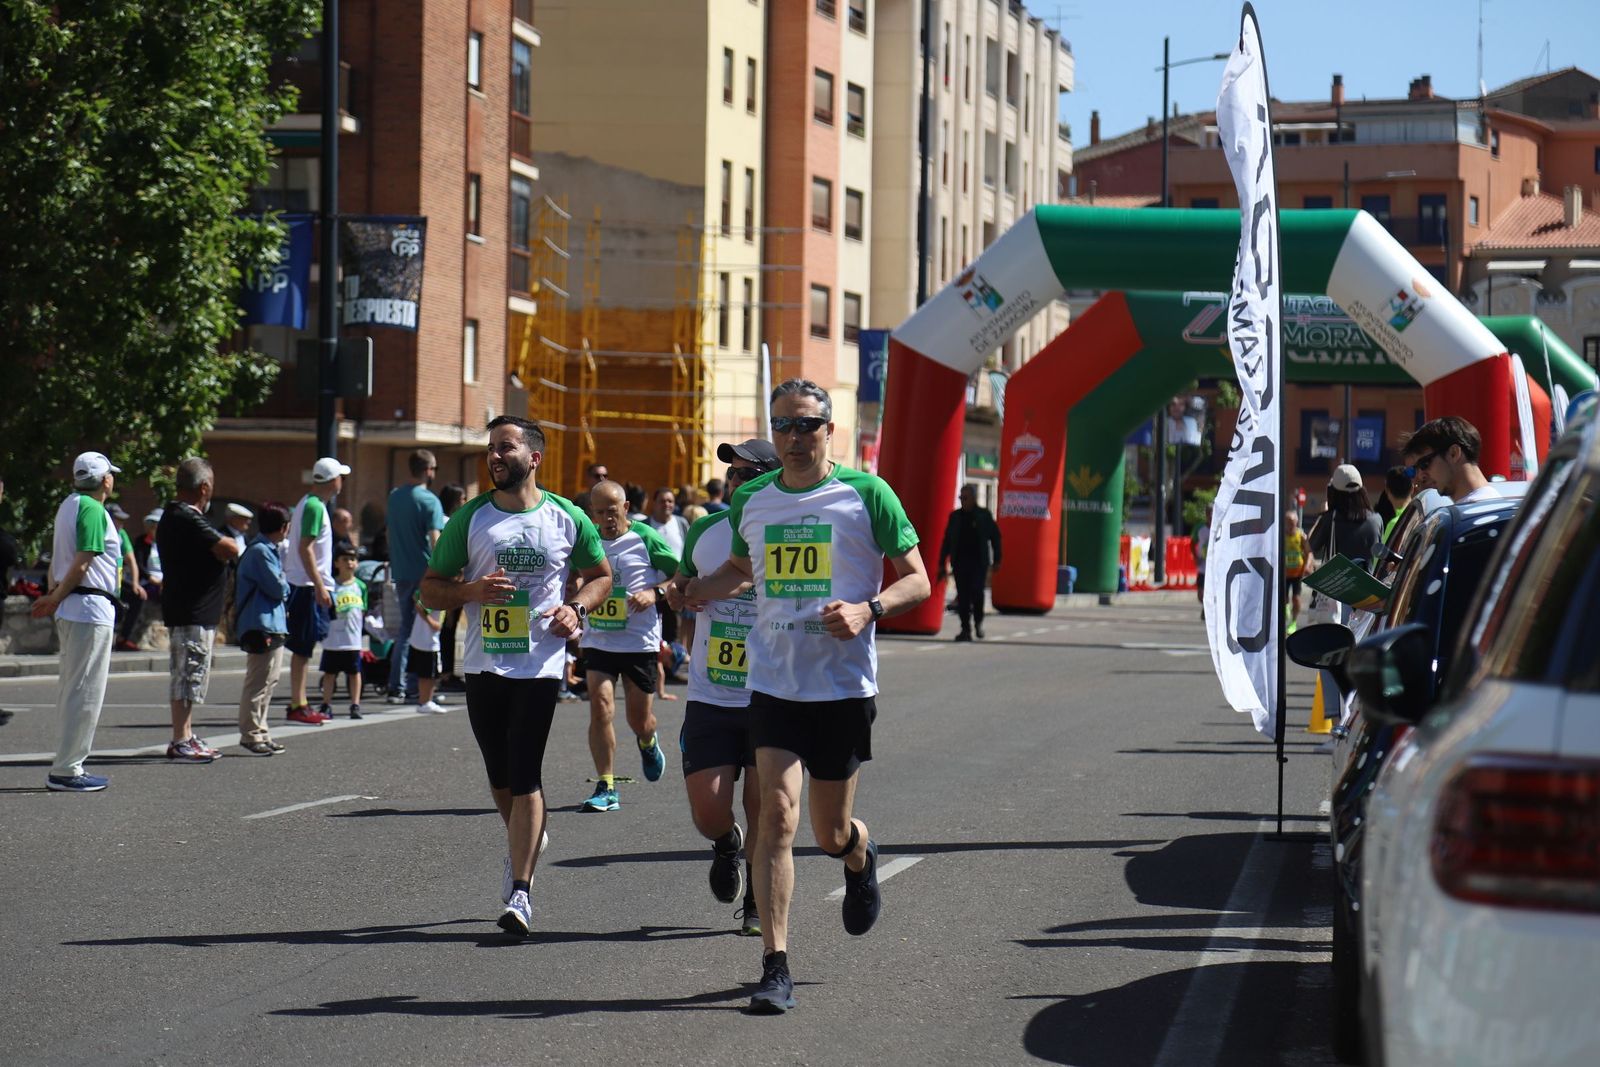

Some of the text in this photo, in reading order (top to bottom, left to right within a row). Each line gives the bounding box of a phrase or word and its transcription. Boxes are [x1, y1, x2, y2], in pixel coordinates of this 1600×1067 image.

[512, 554, 544, 567] CERCO
[770, 546, 818, 574] 170
[803, 584, 828, 592] RURAL
[483, 609, 510, 633] 46
[718, 642, 747, 667] 87
